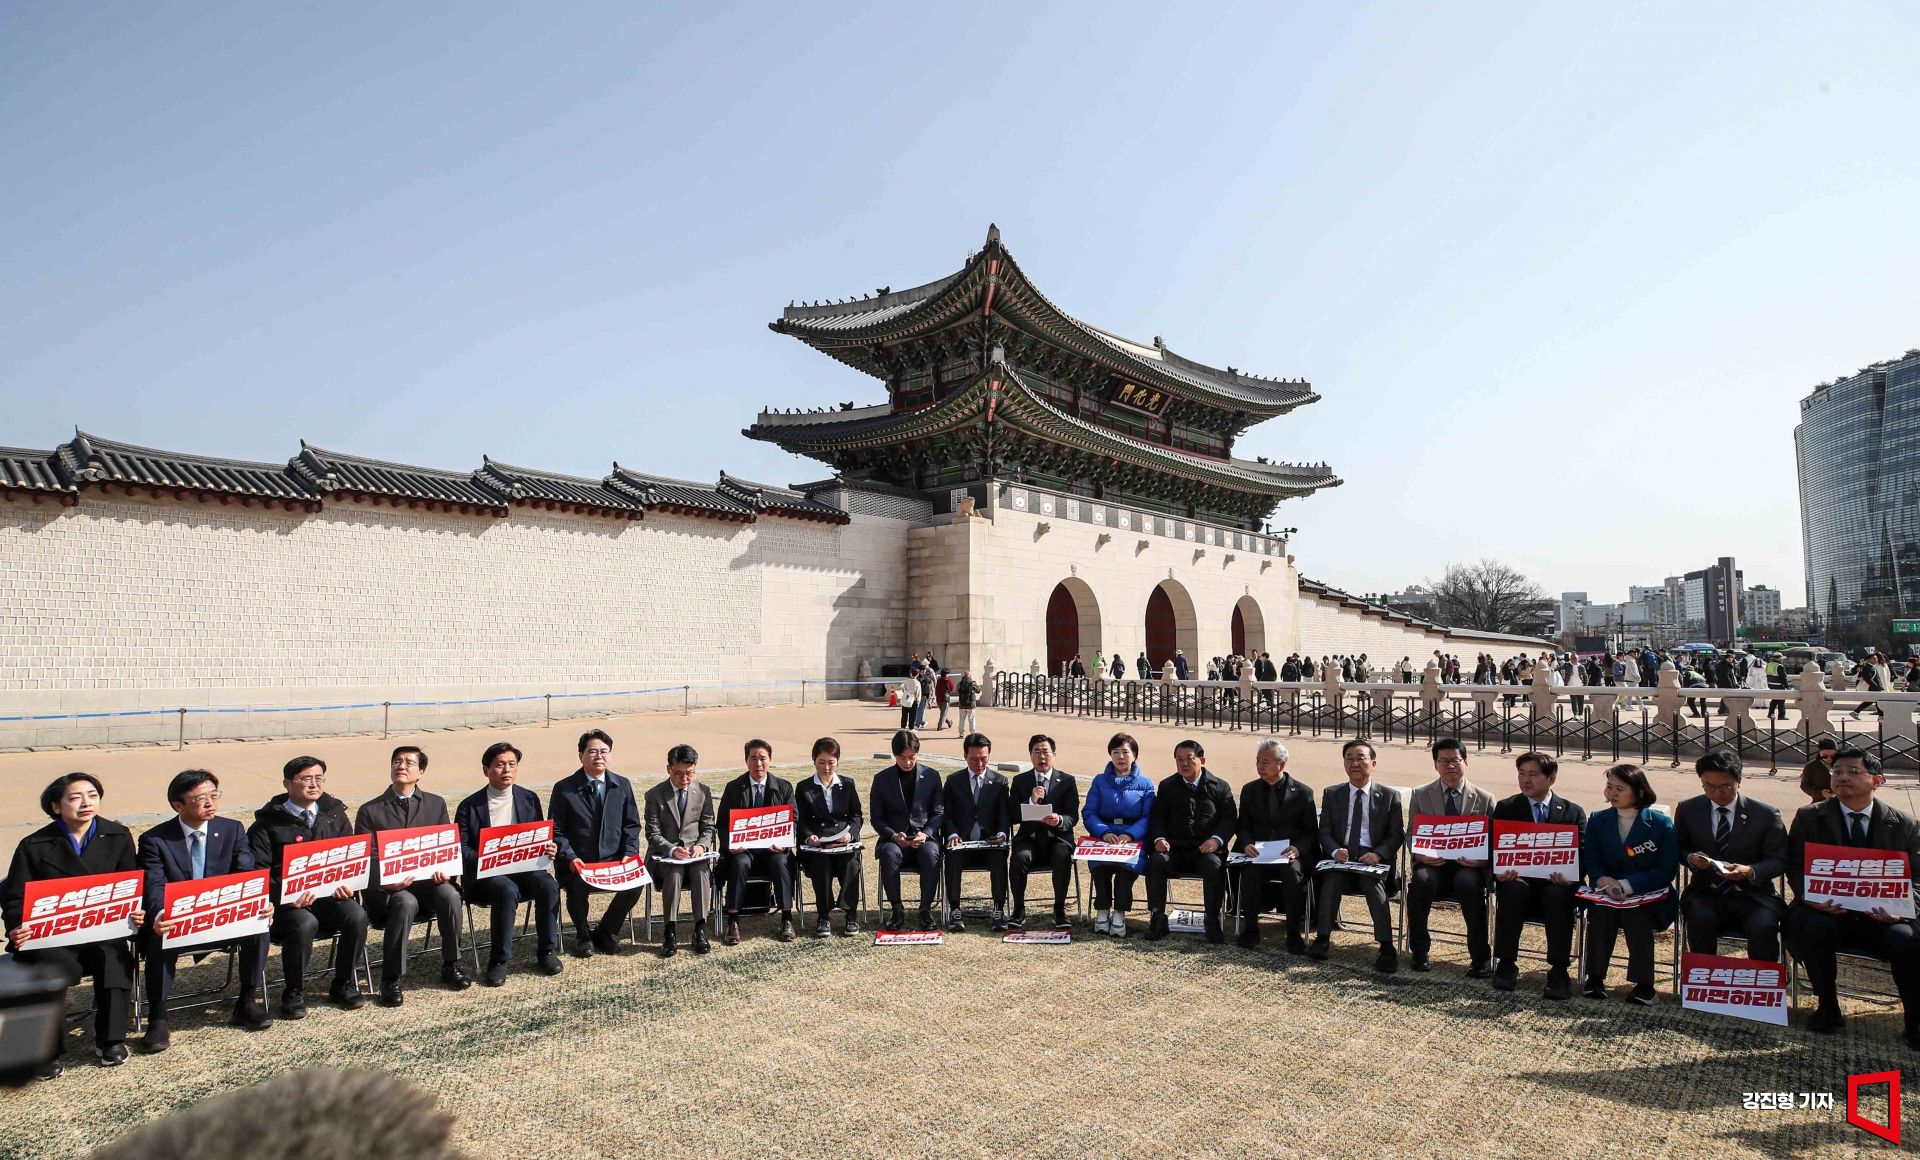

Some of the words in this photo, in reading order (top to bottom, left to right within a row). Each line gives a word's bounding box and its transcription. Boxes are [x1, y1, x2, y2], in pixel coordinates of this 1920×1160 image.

[733, 809, 791, 830] 윤석열을
[1416, 820, 1485, 835] 윤석열을
[383, 828, 457, 858] 윤석열을
[483, 825, 549, 853] 윤석열을
[731, 821, 791, 844] 파면하라!
[1413, 835, 1487, 850] 파면하라!
[1498, 831, 1574, 849] 윤석열을
[287, 841, 367, 876] 윤석열을
[383, 846, 459, 874] 파면하라!
[1495, 851, 1575, 866] 파면하라!
[1809, 858, 1905, 878] 윤석열을
[284, 860, 367, 896] 파면하라!
[585, 868, 645, 885] 파면하라!
[30, 878, 139, 918] 윤석열을
[171, 877, 265, 917] 윤석열을
[1807, 879, 1910, 898] 파면하라!
[27, 901, 139, 940] 파면하라!
[167, 898, 266, 940] 파면하라!
[1688, 968, 1779, 987] 윤석열을
[1685, 988, 1783, 1008] 파면하라!
